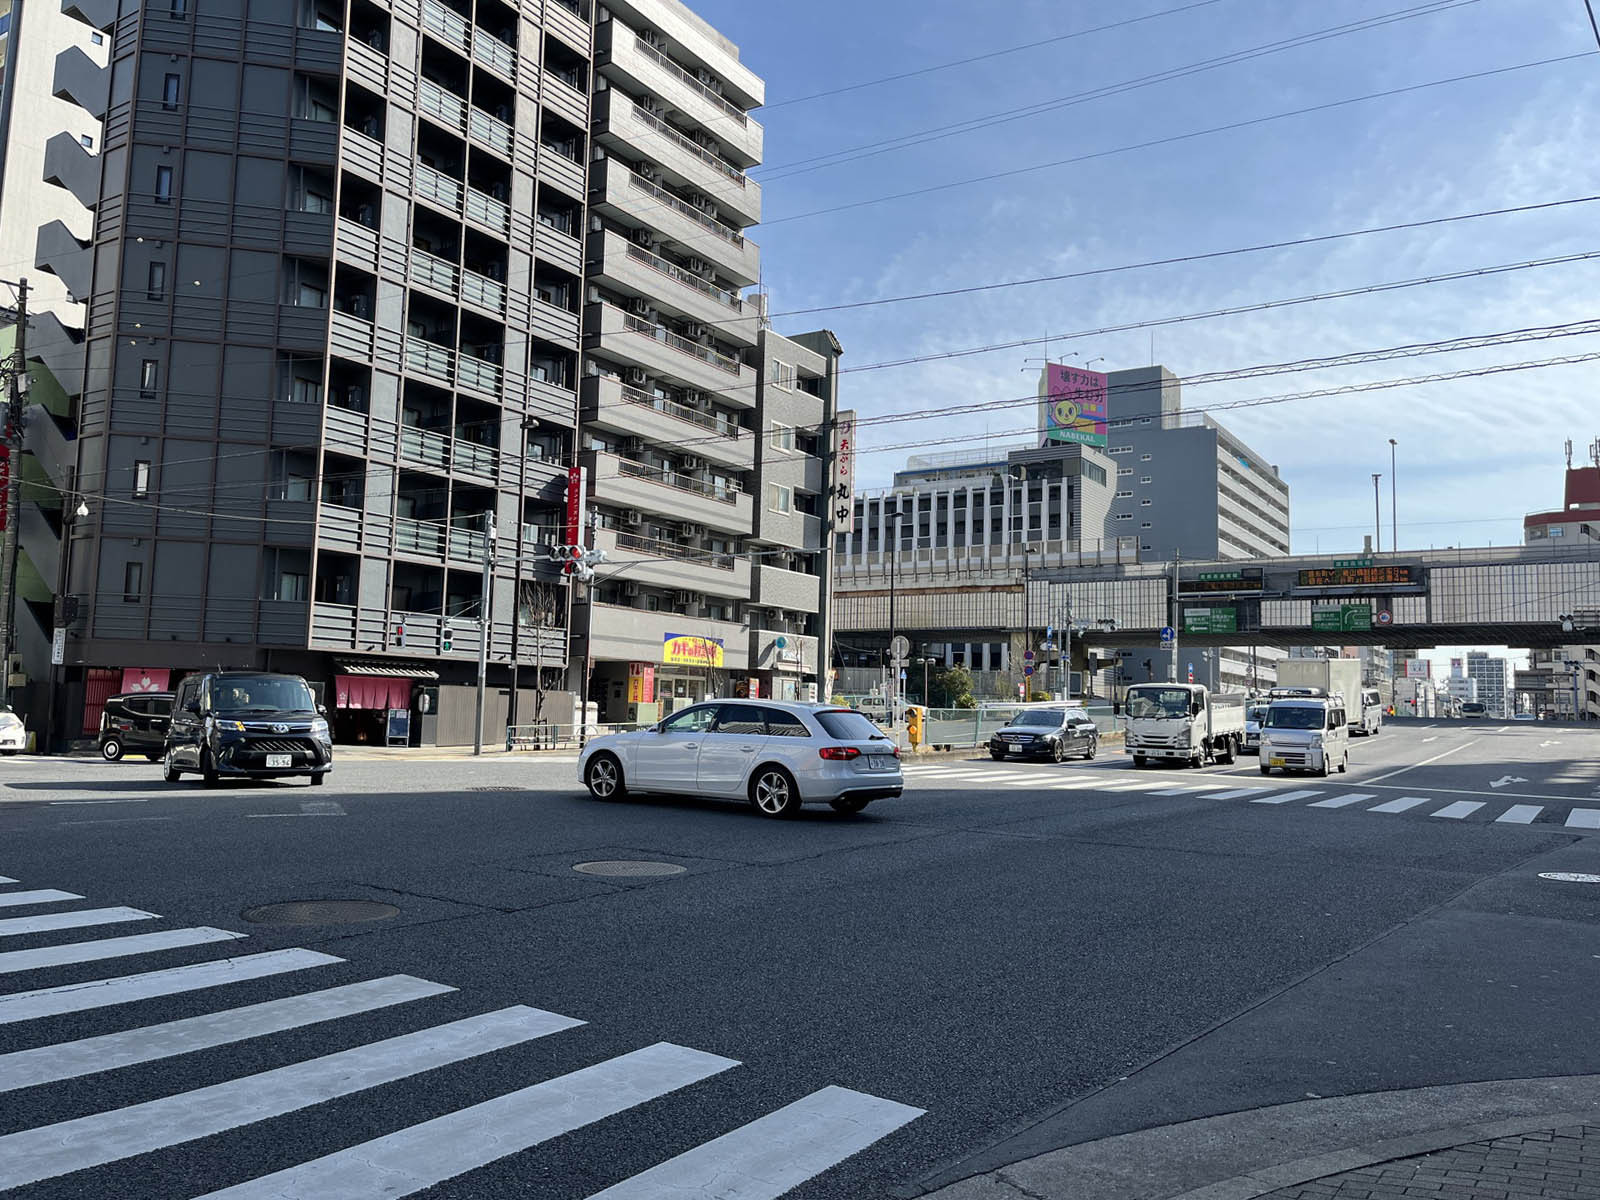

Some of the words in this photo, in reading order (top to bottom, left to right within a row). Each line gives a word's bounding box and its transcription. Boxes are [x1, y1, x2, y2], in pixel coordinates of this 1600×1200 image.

[1060, 370, 1099, 387] 壊す力は
[836, 482, 850, 524] 丸中
